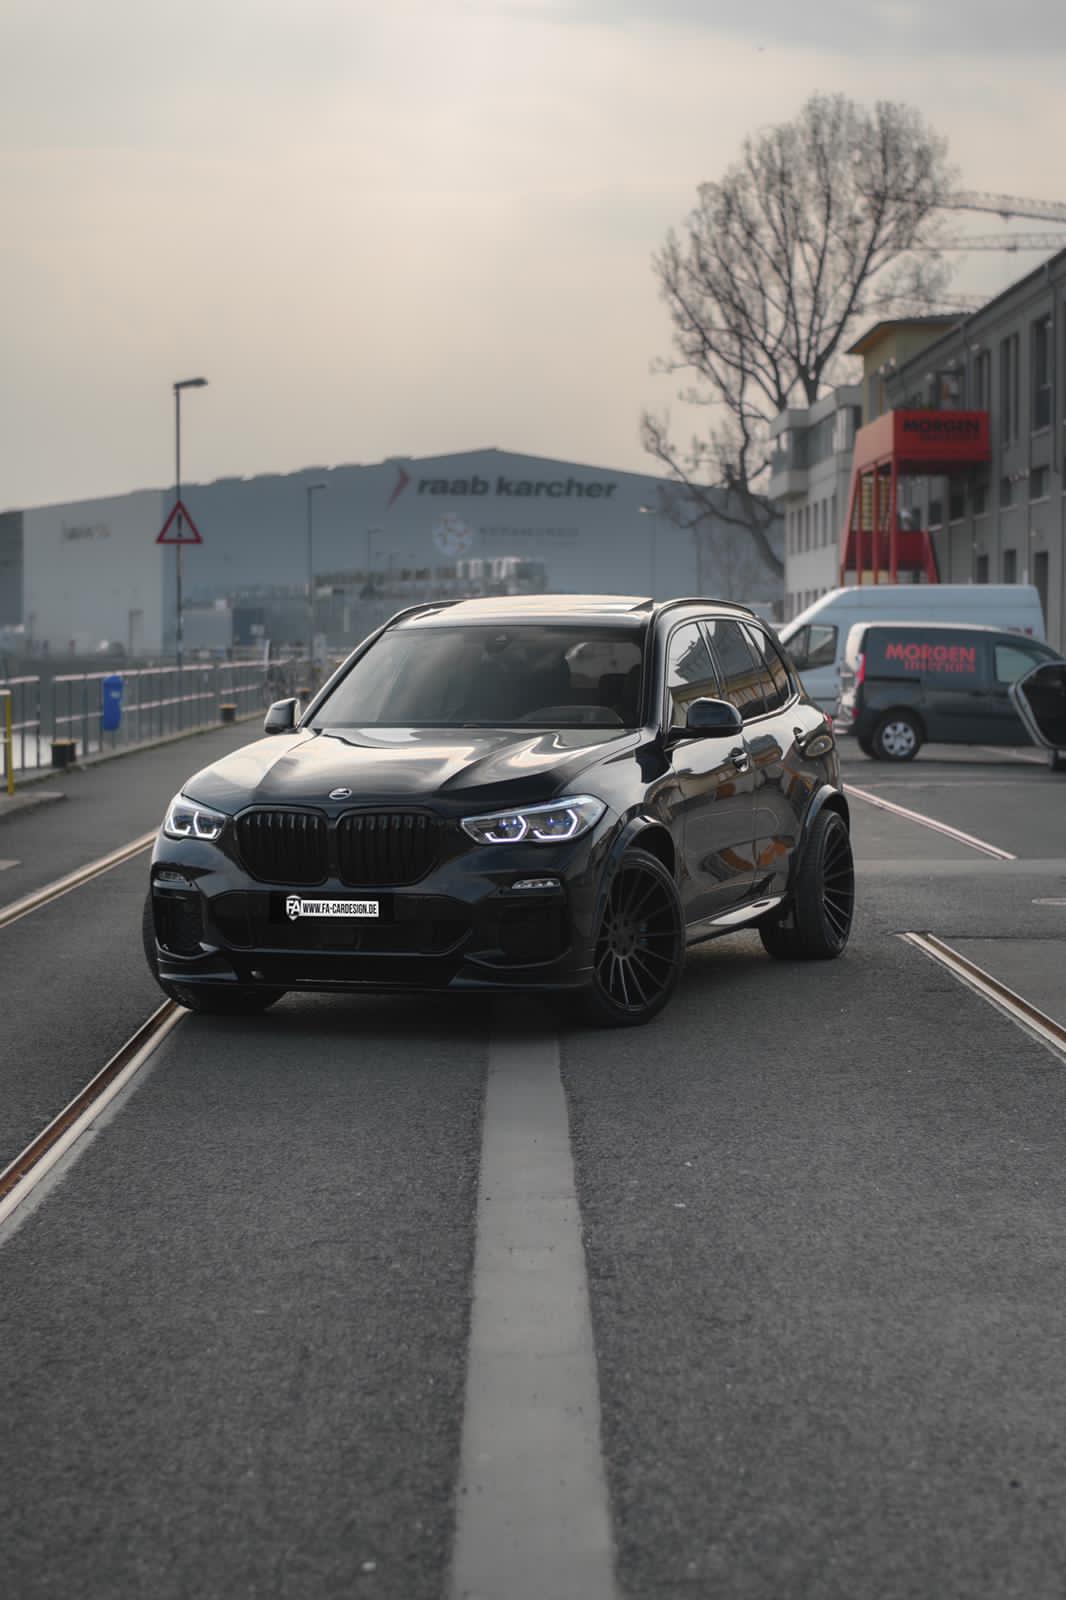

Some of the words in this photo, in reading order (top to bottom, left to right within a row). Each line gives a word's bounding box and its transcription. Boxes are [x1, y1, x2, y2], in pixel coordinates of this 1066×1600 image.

[417, 475, 489, 496] raab
[496, 475, 617, 498] karcher
[886, 643, 976, 662] MORGEN
[303, 902, 378, 914] WWW.FA-CARDESIGN.DE
